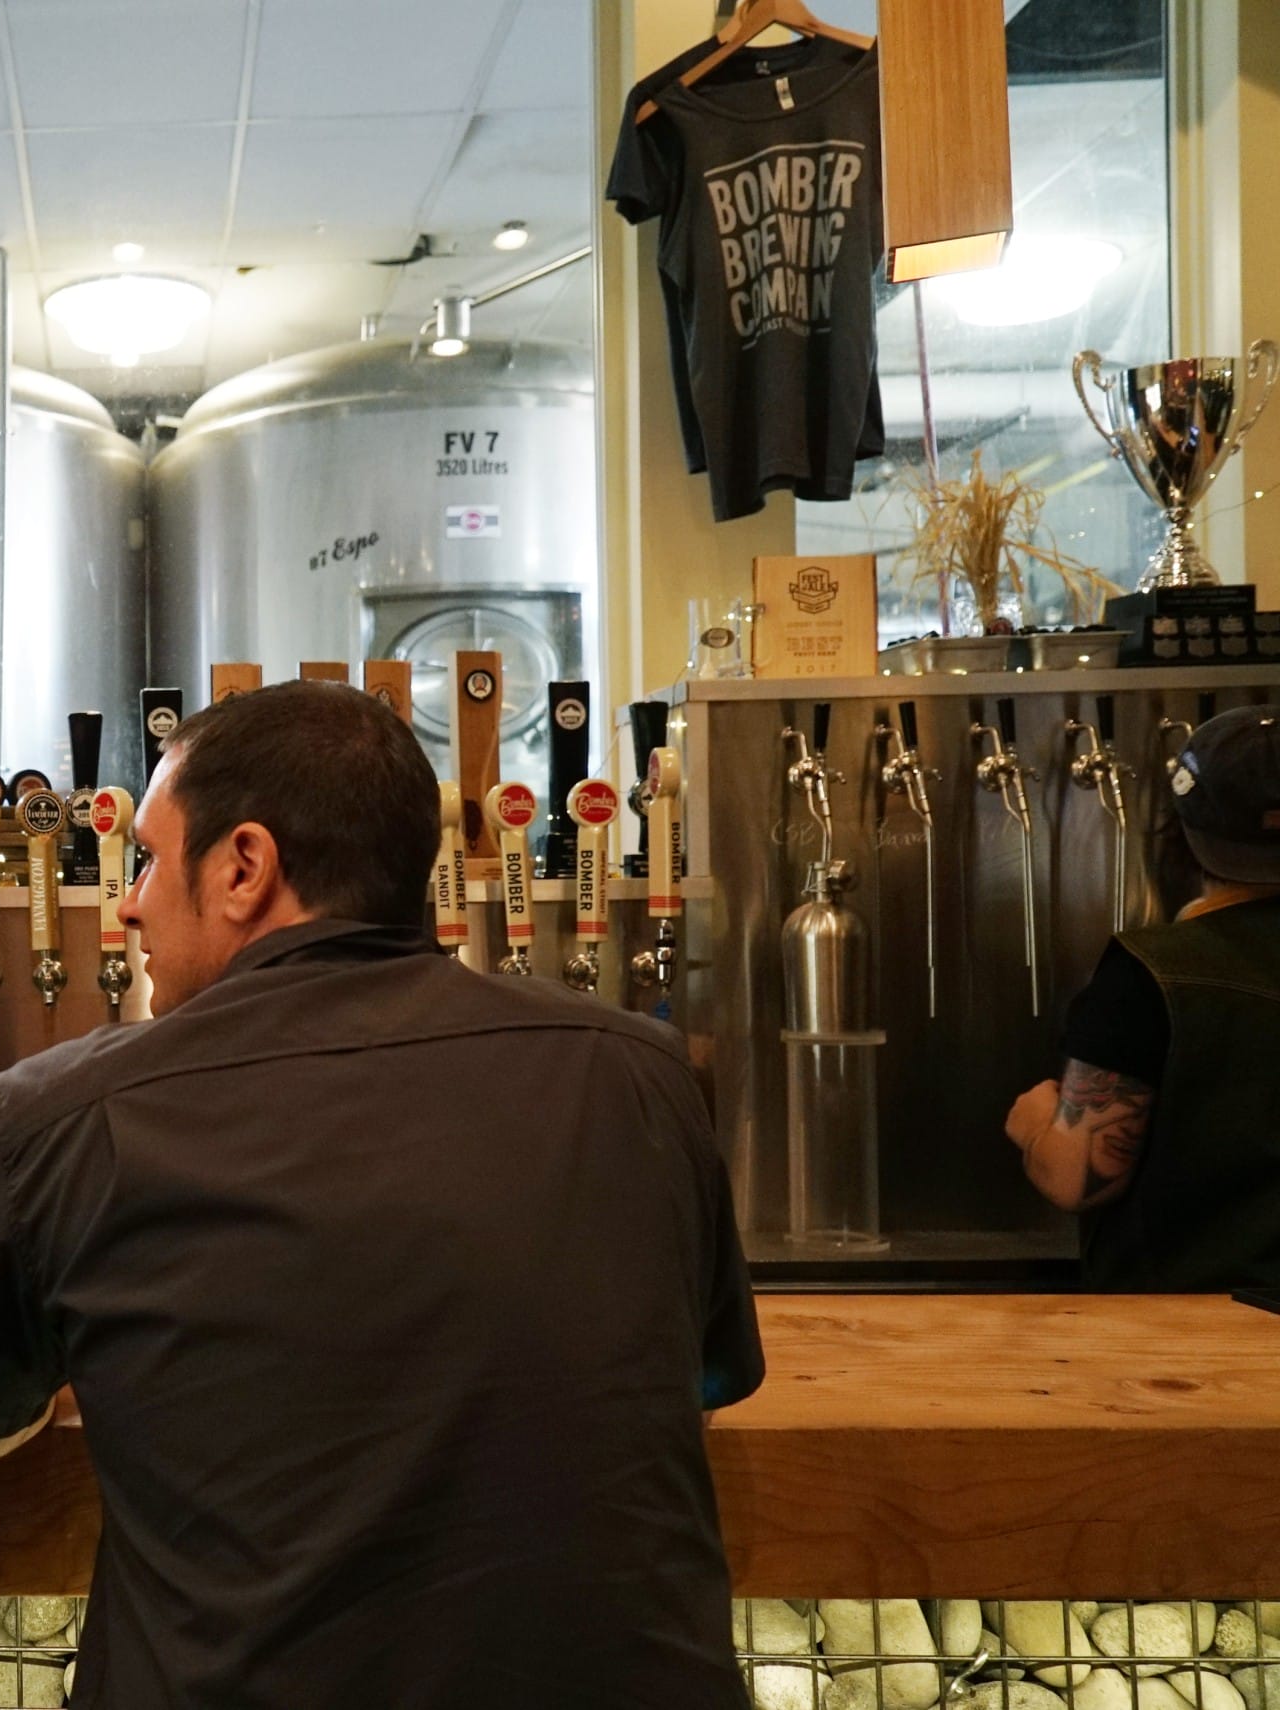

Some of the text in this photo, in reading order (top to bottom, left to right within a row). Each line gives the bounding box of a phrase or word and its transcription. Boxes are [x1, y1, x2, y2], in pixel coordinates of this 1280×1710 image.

[707, 153, 862, 234] BOMBER
[721, 212, 845, 288] BREWING
[730, 267, 835, 337] COMPAN
[436, 458, 509, 477] 3520 Litres
[445, 431, 499, 454] FV 7
[454, 850, 466, 911] BOMBER
[506, 853, 525, 914] BOMBER
[580, 850, 593, 911] BOMBER
[672, 822, 681, 884] BOMBER
[106, 879, 118, 900] IPA
[438, 864, 450, 909] BANDIT
